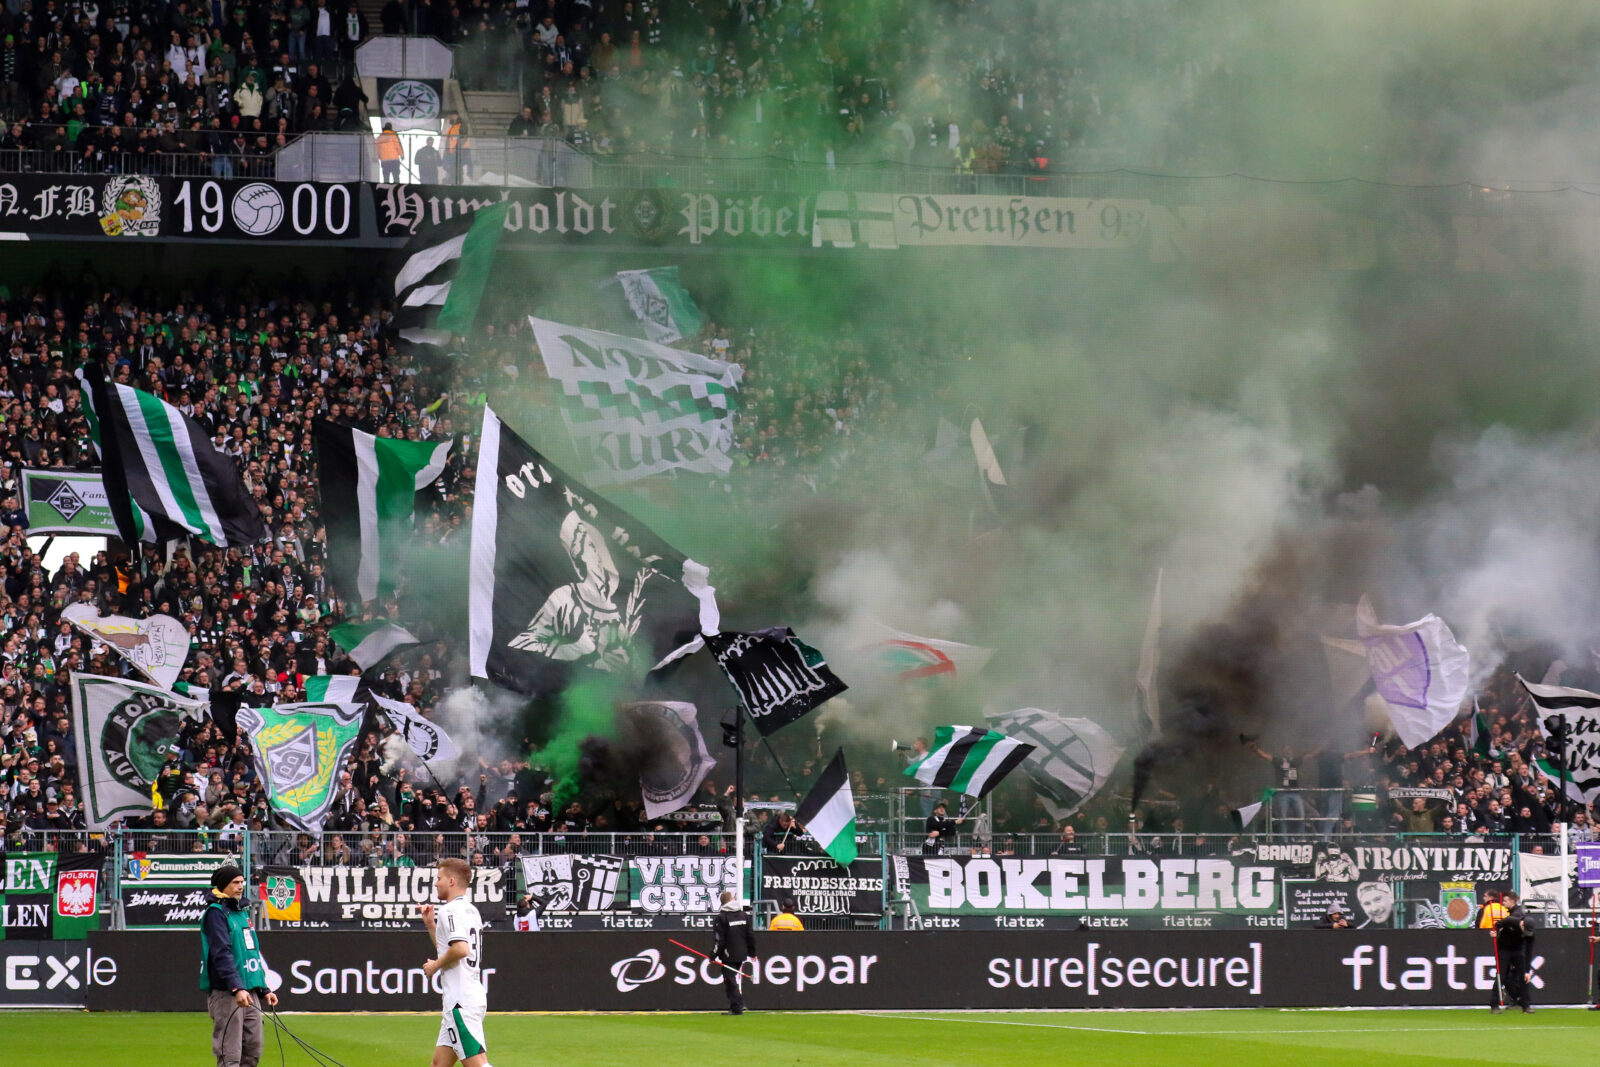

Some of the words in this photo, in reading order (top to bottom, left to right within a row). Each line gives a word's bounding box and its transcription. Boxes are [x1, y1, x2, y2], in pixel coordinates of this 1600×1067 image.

[376, 183, 617, 236] Humboldt
[676, 191, 808, 244] Pöbel
[897, 195, 1077, 241] Preußen
[1258, 844, 1314, 860] BANDA
[1354, 847, 1511, 871] FRONTLINE
[150, 860, 221, 871] Gummersbach
[634, 855, 738, 885] VITUS
[0, 859, 54, 890] EN
[60, 872, 96, 880] POLSKA
[924, 854, 1275, 910] BÖKELBERG
[1451, 872, 1474, 882] seit
[300, 866, 504, 903] WILLICR
[763, 875, 884, 891] FREUNDESKREIS
[538, 916, 573, 928] atex
[602, 915, 653, 928] flatex
[681, 916, 714, 928] flat
[908, 916, 960, 928] fatex
[994, 916, 1045, 928] flatex
[1079, 916, 1129, 928] flatex
[1163, 916, 1212, 928] flatex
[1246, 916, 1285, 928] flate
[674, 955, 878, 992] sonepar
[987, 942, 1262, 996] sure[secure]
[290, 959, 496, 996] Santanr
